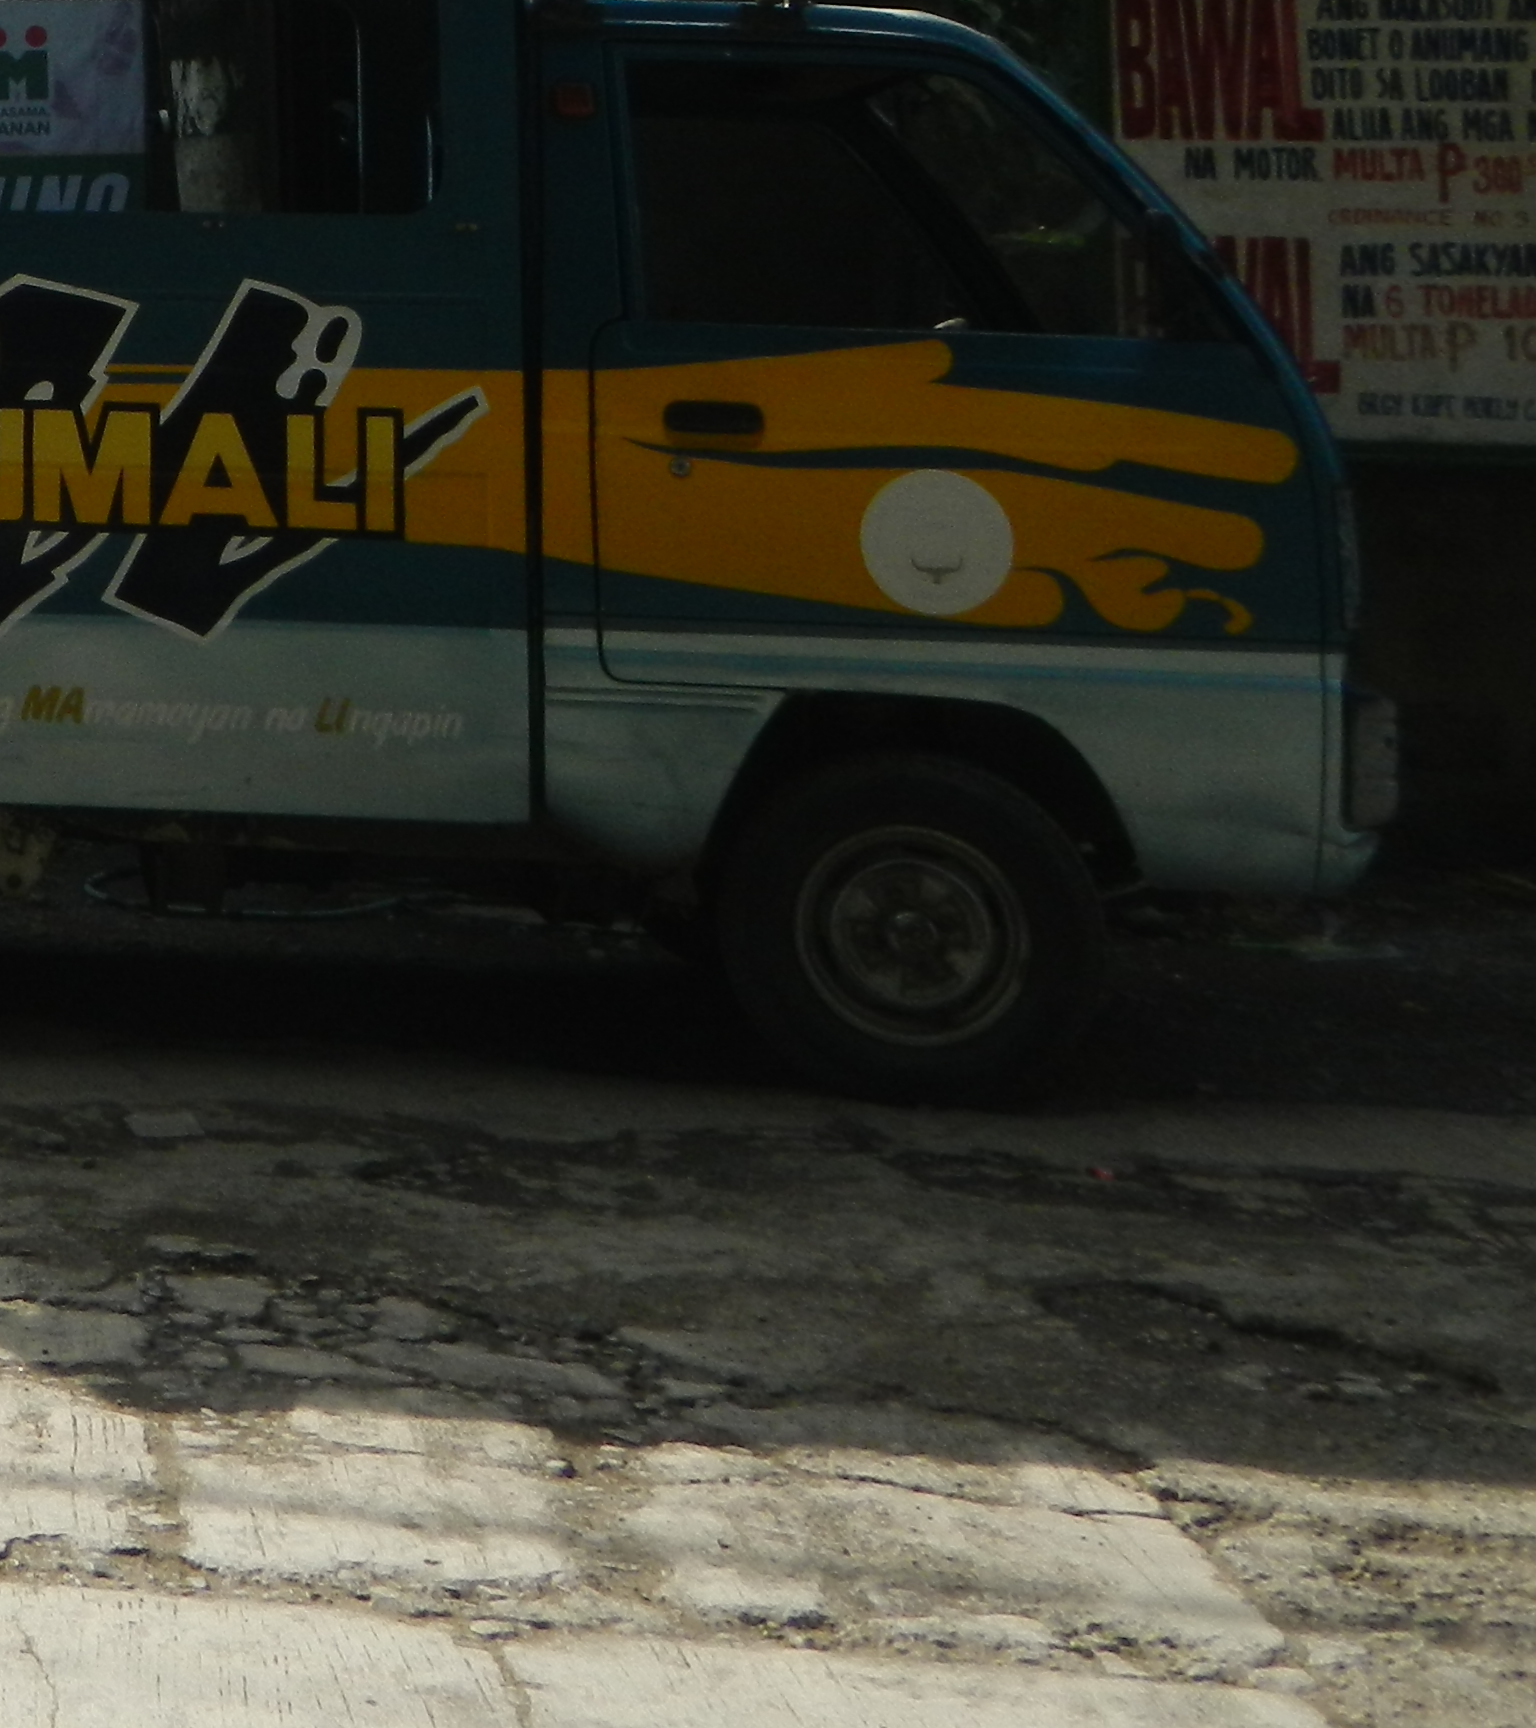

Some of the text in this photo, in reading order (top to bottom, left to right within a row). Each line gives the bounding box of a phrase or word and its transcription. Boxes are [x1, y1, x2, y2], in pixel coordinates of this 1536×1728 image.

[1306, 27, 1528, 62] BONET O ANUMANG
[1310, 68, 1365, 101] DITO
[1376, 68, 1405, 101] SA
[1413, 67, 1510, 103] LOOBAN
[1332, 107, 1393, 142] ALUA
[1400, 108, 1450, 141] ANG
[1462, 107, 1515, 141] MGA
[1184, 147, 1217, 181] NA
[1332, 147, 1425, 183] MULTA
[1339, 243, 1396, 276] ANG
[1341, 285, 1376, 320] NA
[1383, 285, 1405, 320] 6
[1341, 323, 1435, 363] MULTA
